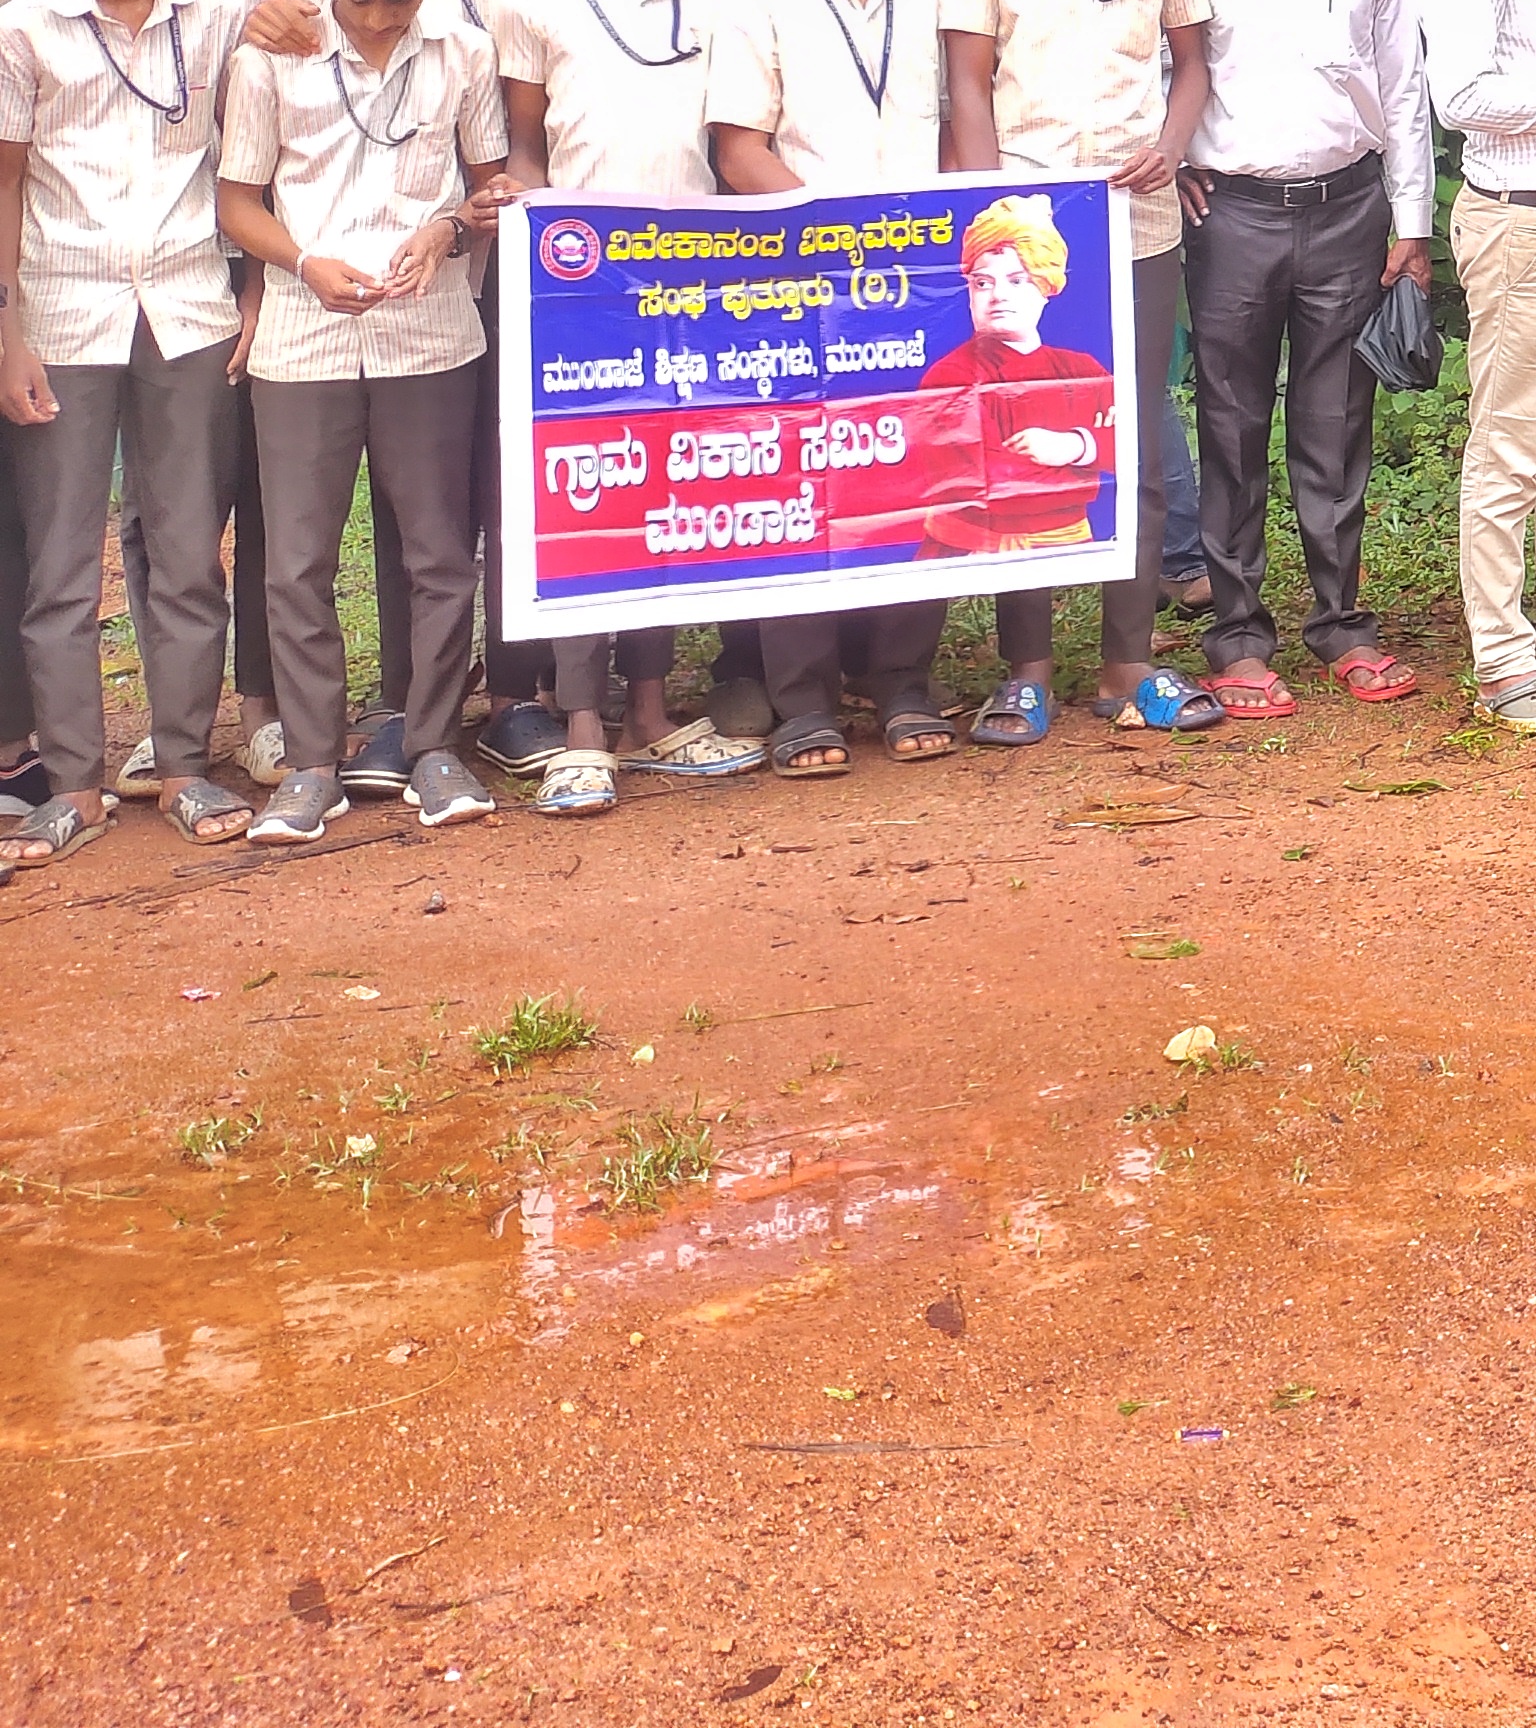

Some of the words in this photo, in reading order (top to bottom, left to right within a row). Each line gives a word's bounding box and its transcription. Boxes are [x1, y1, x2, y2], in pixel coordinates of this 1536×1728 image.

[606, 223, 785, 262] ವಿವೇಕಾನಂದ
[798, 210, 954, 266] ವಿದ್ಯಾವರ್ಧಕ
[638, 280, 708, 320] ಸಂಘ
[721, 274, 833, 320] ಪುತ್ತೂರು
[850, 264, 910, 309] (ರಿ.)
[542, 348, 645, 393] ಮುಂಡಾಜೆ
[655, 346, 708, 400] ಶಿಕ್ಷಣ
[717, 339, 818, 398] ಸಂಸ್ಥೆಗಳು,
[825, 329, 926, 374] ಮುಂಡಾಜೆ
[545, 427, 648, 512] ಗ್ರಾಮ
[667, 416, 782, 482] ವಿಕಾಸ
[800, 414, 907, 473] ಸಮಿತಿ
[645, 482, 817, 554] ಮುಂಡಾಜೆ
